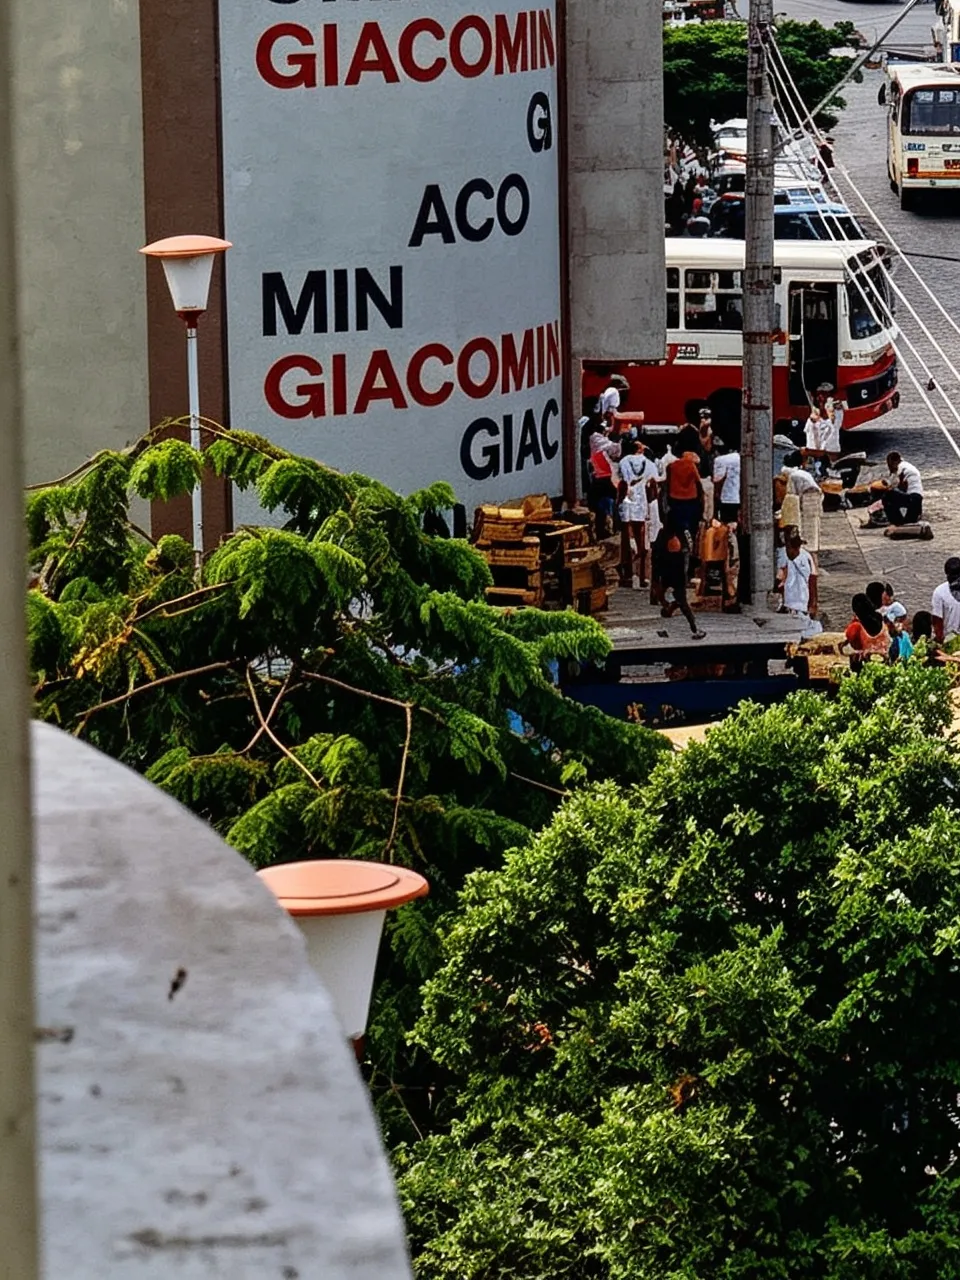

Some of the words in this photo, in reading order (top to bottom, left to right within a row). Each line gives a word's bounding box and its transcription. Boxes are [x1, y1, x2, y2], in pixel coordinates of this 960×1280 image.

[255, 9, 555, 90] GIACOMIN
[408, 173, 530, 247] ACO
[262, 265, 403, 336] MIN
[263, 320, 560, 420] GIACOMIN
[459, 398, 560, 481] GIAC
